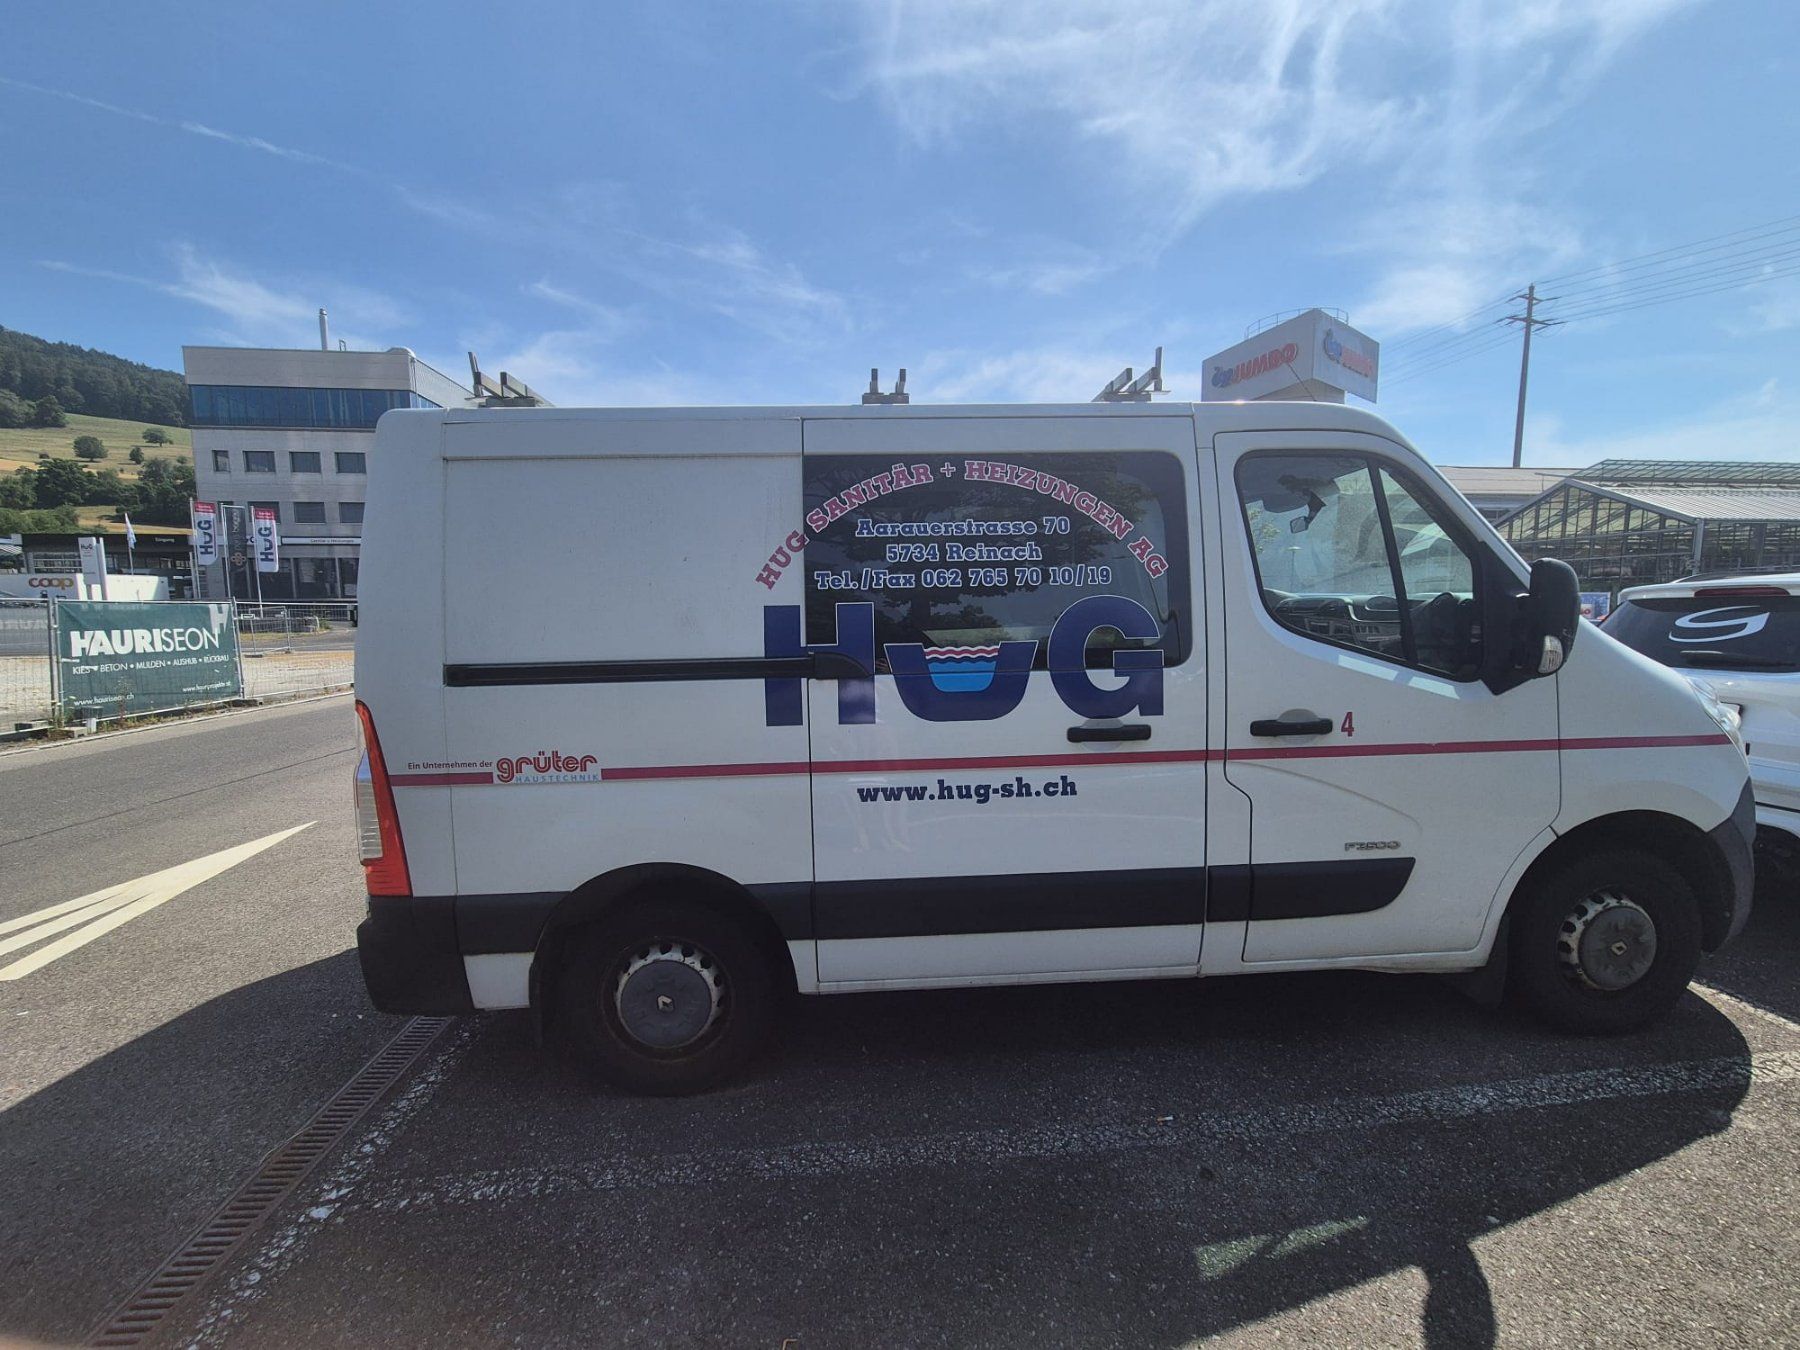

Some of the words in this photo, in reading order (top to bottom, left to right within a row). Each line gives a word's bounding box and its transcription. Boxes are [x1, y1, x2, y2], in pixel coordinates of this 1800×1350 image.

[1231, 343, 1298, 384] JUMBO
[197, 520, 213, 555] HUG
[755, 530, 810, 590] HUG
[806, 462, 933, 533] SANITÄR
[940, 463, 956, 477] +
[964, 460, 1134, 540] HEIZUNGEN
[1128, 536, 1168, 579] AG
[856, 519, 1037, 537] Aarauerstrasse
[1043, 516, 1070, 534] 70
[258, 527, 274, 562] HUG
[886, 543, 939, 562] 5734
[946, 541, 1042, 561] Reinach
[28, 577, 74, 590] coop
[814, 568, 915, 590] Tel./Fax
[921, 568, 962, 587] 062
[969, 567, 1008, 586] 765
[1015, 567, 1041, 586] 70
[1050, 563, 1112, 587] 10/19
[70, 627, 220, 658] HAURISEON
[100, 662, 128, 673] BETON
[136, 659, 166, 670] MULDEN
[173, 657, 198, 667] AUSHUB
[203, 654, 229, 664] RÜCKBAU
[763, 594, 1165, 727] HUG
[1341, 711, 1355, 737] 4
[422, 761, 477, 770] Unternehmen
[479, 760, 493, 768] der
[496, 750, 598, 783] grüter
[516, 774, 600, 784] HAUSTECHNIK
[857, 776, 1077, 803] www.hug-sh.ch
